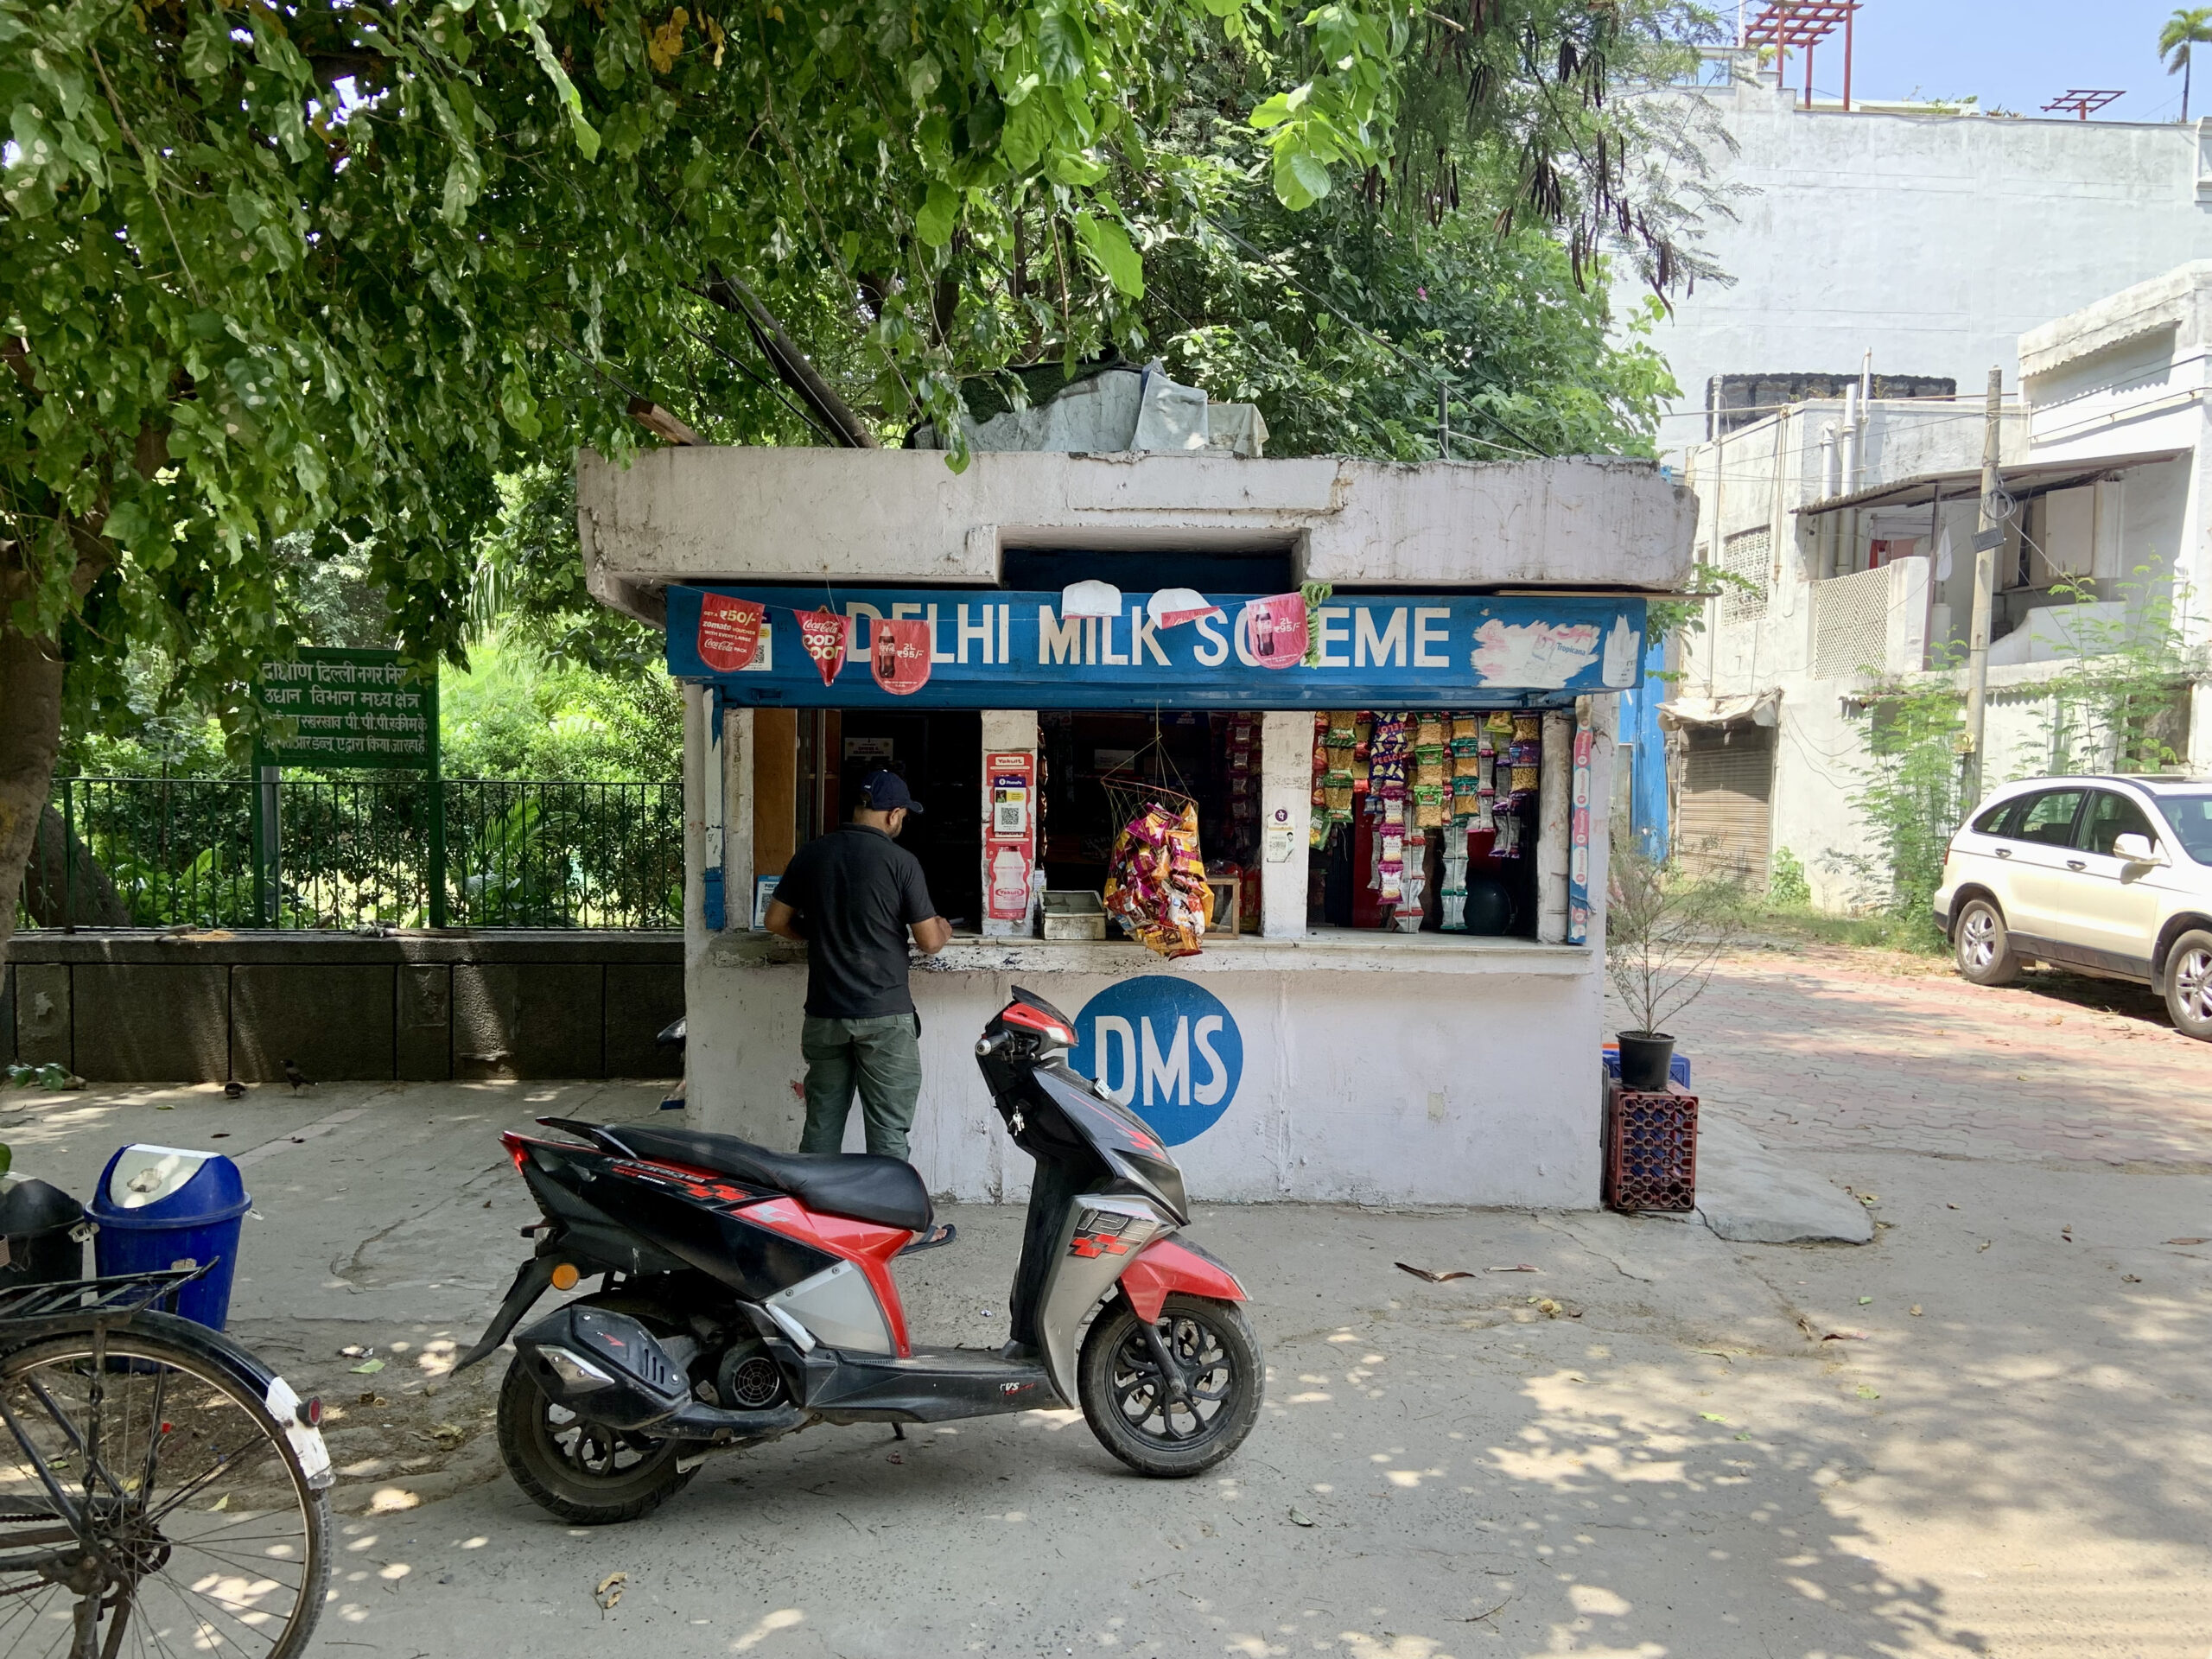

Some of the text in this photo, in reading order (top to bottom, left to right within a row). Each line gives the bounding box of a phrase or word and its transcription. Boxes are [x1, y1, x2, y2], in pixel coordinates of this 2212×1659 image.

[702, 621, 732, 631] zomato
[1280, 616, 1293, 625] 2L
[804, 634, 836, 646] OOD
[1039, 605, 1173, 666] MILK
[1193, 607, 1451, 667] SCEME
[810, 645, 844, 660] OOT
[1556, 642, 1586, 657] Tropicana
[315, 659, 357, 683] दिल्ली
[358, 666, 384, 685] नगर
[308, 683, 357, 706] विभाग
[395, 688, 422, 710] क्षेत्र
[1095, 1015, 1228, 1107] DMS
[999, 1382, 1020, 1392] TVS
